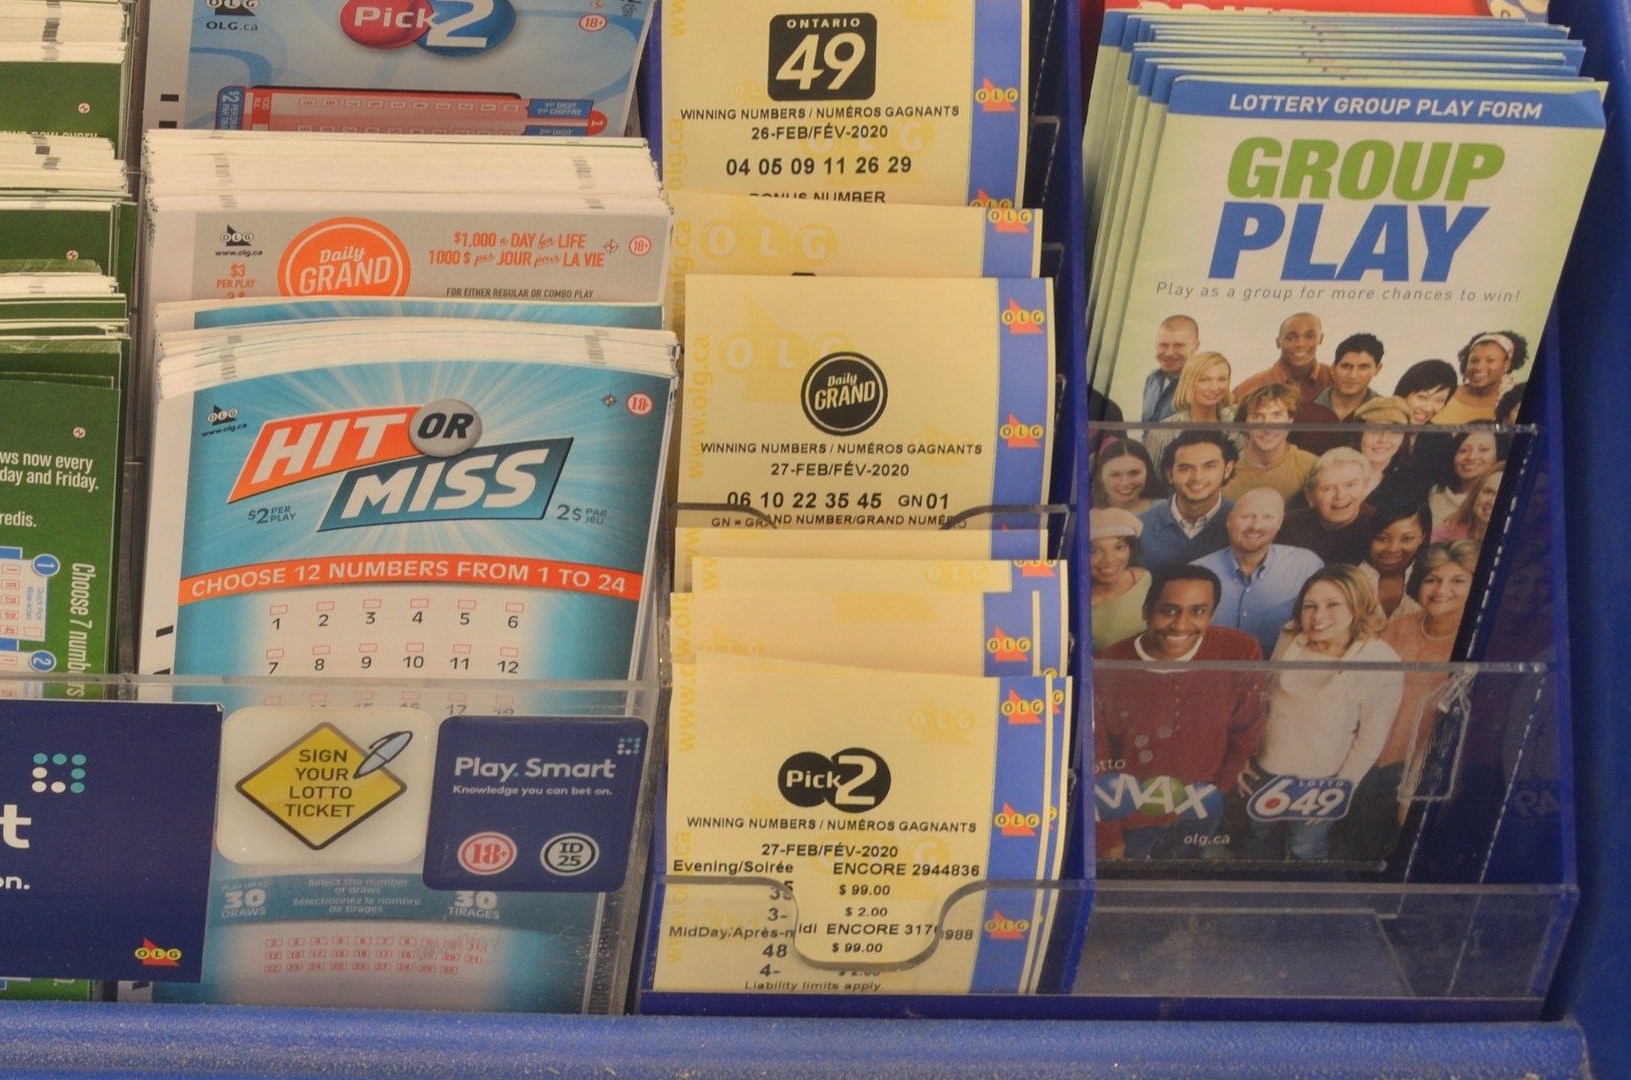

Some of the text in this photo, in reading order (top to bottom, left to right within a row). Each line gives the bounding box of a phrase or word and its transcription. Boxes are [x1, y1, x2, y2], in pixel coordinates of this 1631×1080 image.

[354, 7, 441, 28] Pick
[787, 18, 860, 29] ONTARIO
[775, 32, 866, 90] 49
[1229, 93, 1542, 119] LOTTERY GROUP PLAY FORM
[751, 125, 888, 139] 26-FEB/FÉV-2020
[726, 156, 911, 176] 04 05 09 11 26 29
[1227, 137, 1505, 201] GROUP
[1208, 201, 1490, 282] PLAY
[319, 246, 366, 263] Daily
[298, 256, 392, 293] GRAND
[1155, 281, 1520, 303] Play as a group for more chances to win!
[827, 373, 857, 386] Daily
[814, 381, 876, 411] GRAND
[252, 412, 473, 484] HIT OR
[24, 451, 52, 467] now
[56, 454, 94, 472] every
[771, 462, 910, 477] 27-FEB/FÉV-2020
[26, 469, 52, 484] and
[56, 468, 99, 492] Friday.
[340, 448, 549, 519] MISS
[191, 560, 625, 597] CHOOSE 12 NUMBERS FROM 1 TO 24
[298, 749, 348, 763] SIGN
[295, 768, 349, 781] YOUR
[786, 754, 876, 806] Pick 2
[289, 786, 352, 800] LOTTO
[1255, 778, 1346, 816] 649
[285, 804, 354, 818] TICKET
[687, 817, 744, 828] WINNING
[749, 819, 816, 829] NUMBERS
[827, 817, 895, 831] NUMÉROS
[900, 821, 976, 832] GAGNANTS
[761, 842, 898, 858] 27-FEB/FÉV-2020
[1183, 833, 1230, 846] olg.ca
[833, 863, 906, 875] ENCORE
[912, 863, 980, 877] 2944836
